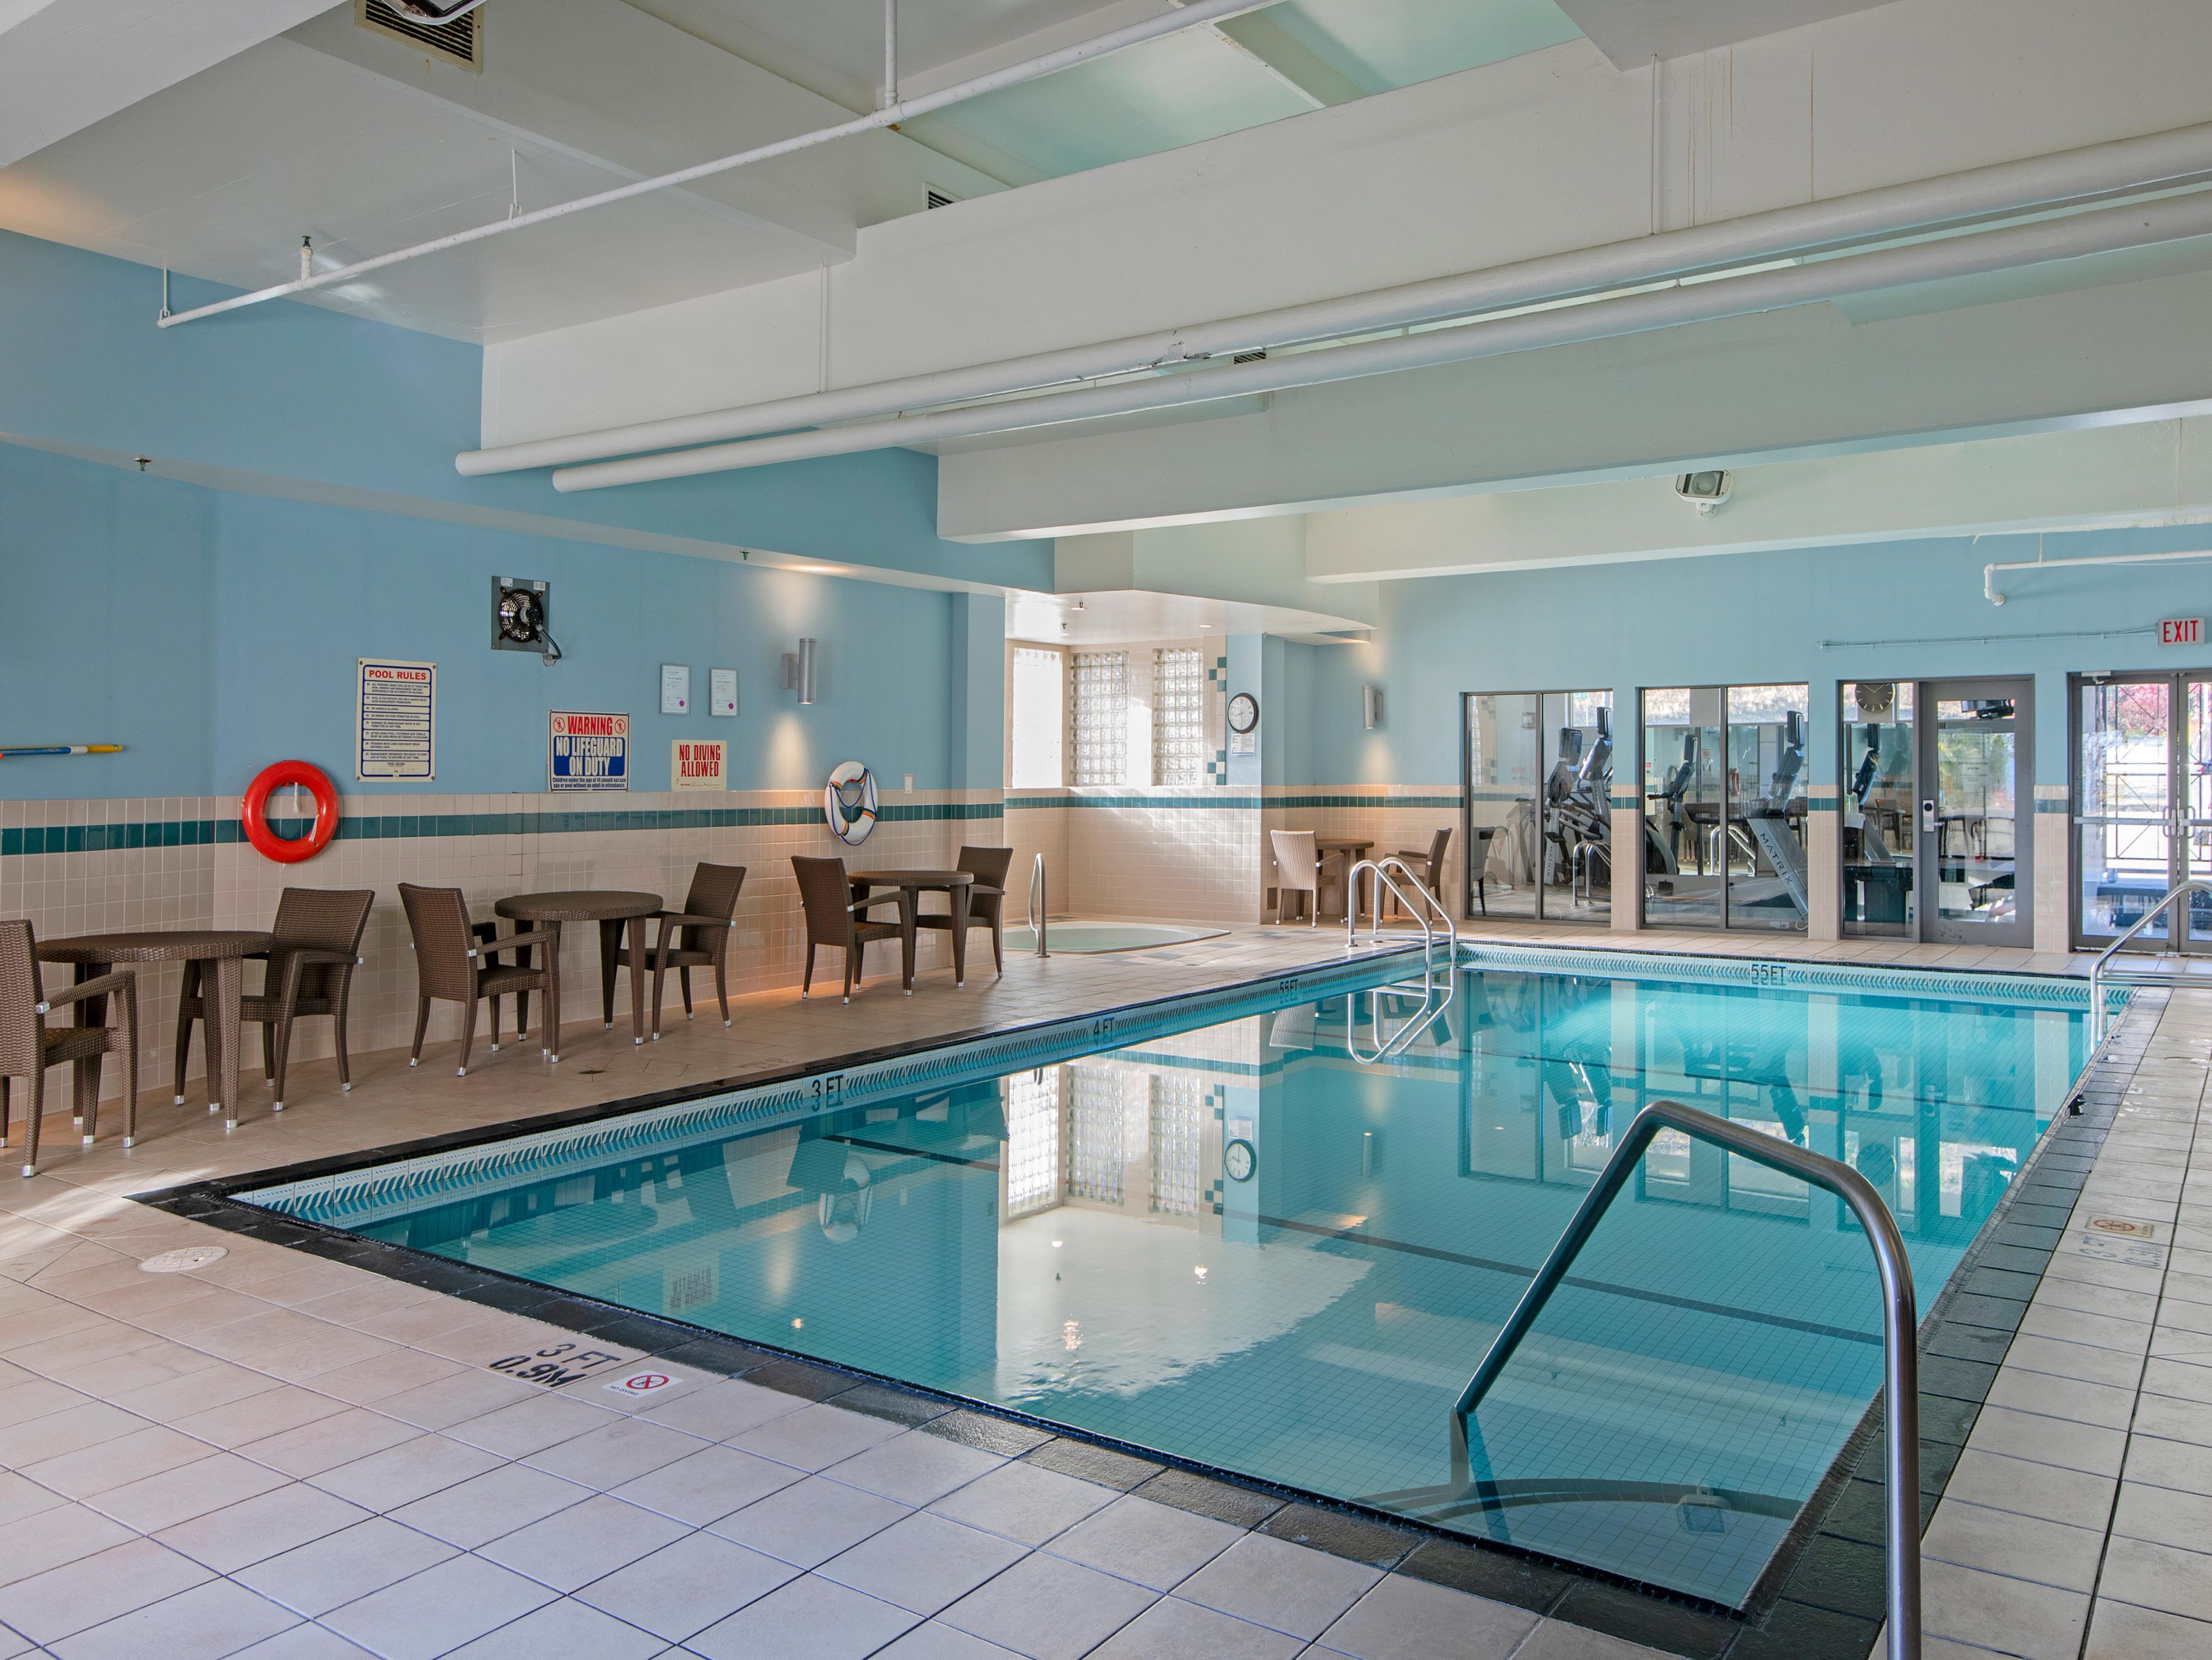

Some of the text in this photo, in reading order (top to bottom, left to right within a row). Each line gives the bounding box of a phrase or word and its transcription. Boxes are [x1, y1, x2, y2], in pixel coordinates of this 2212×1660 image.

[2163, 620, 2198, 643] EXIT
[369, 670, 426, 680] POOL RULES
[567, 716, 613, 736] WARNING
[556, 737, 623, 757] NO LIFEGUARD
[680, 745, 721, 761] NO DIVING
[569, 756, 611, 776] ON DUTY
[681, 761, 718, 777] ALLOWED
[1760, 833, 1793, 884] MATRIX
[1093, 1017, 1115, 1035] 4 FT
[811, 1074, 843, 1097] 3 FT
[536, 1344, 622, 1369] 3 FT
[489, 1355, 587, 1387] 0.9M
